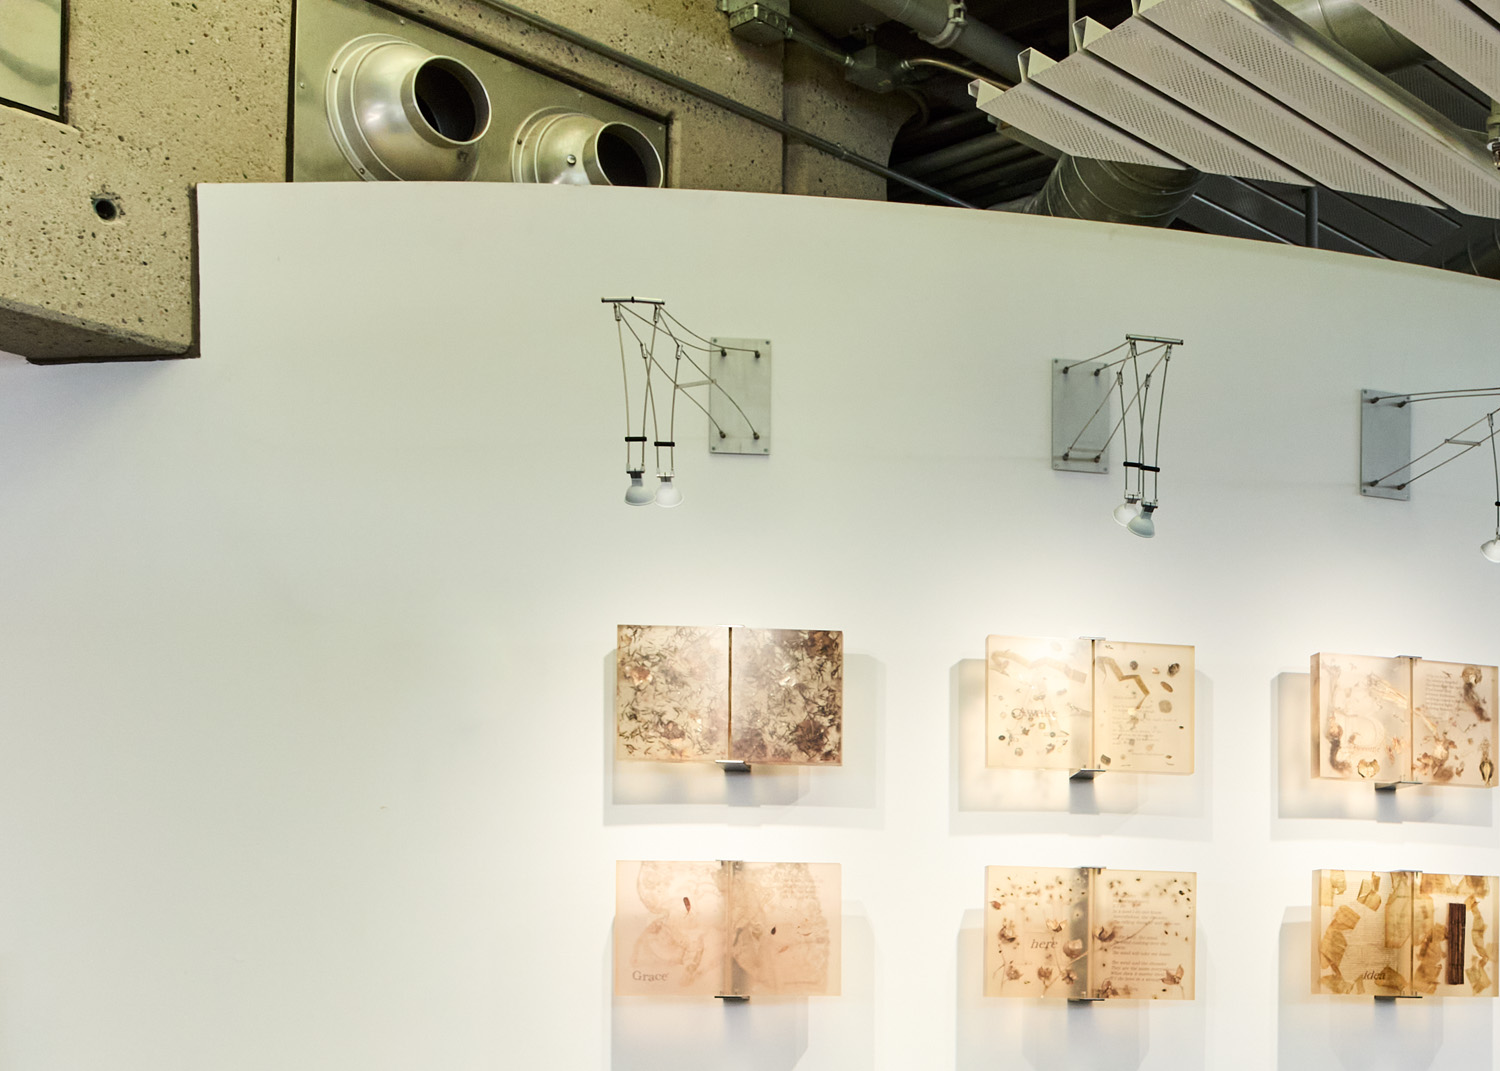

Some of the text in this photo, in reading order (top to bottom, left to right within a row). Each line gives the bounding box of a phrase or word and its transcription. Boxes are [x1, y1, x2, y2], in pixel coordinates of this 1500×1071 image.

[1031, 938, 1058, 949] here
[632, 970, 669, 982] Grace
[1363, 970, 1386, 980] idea
